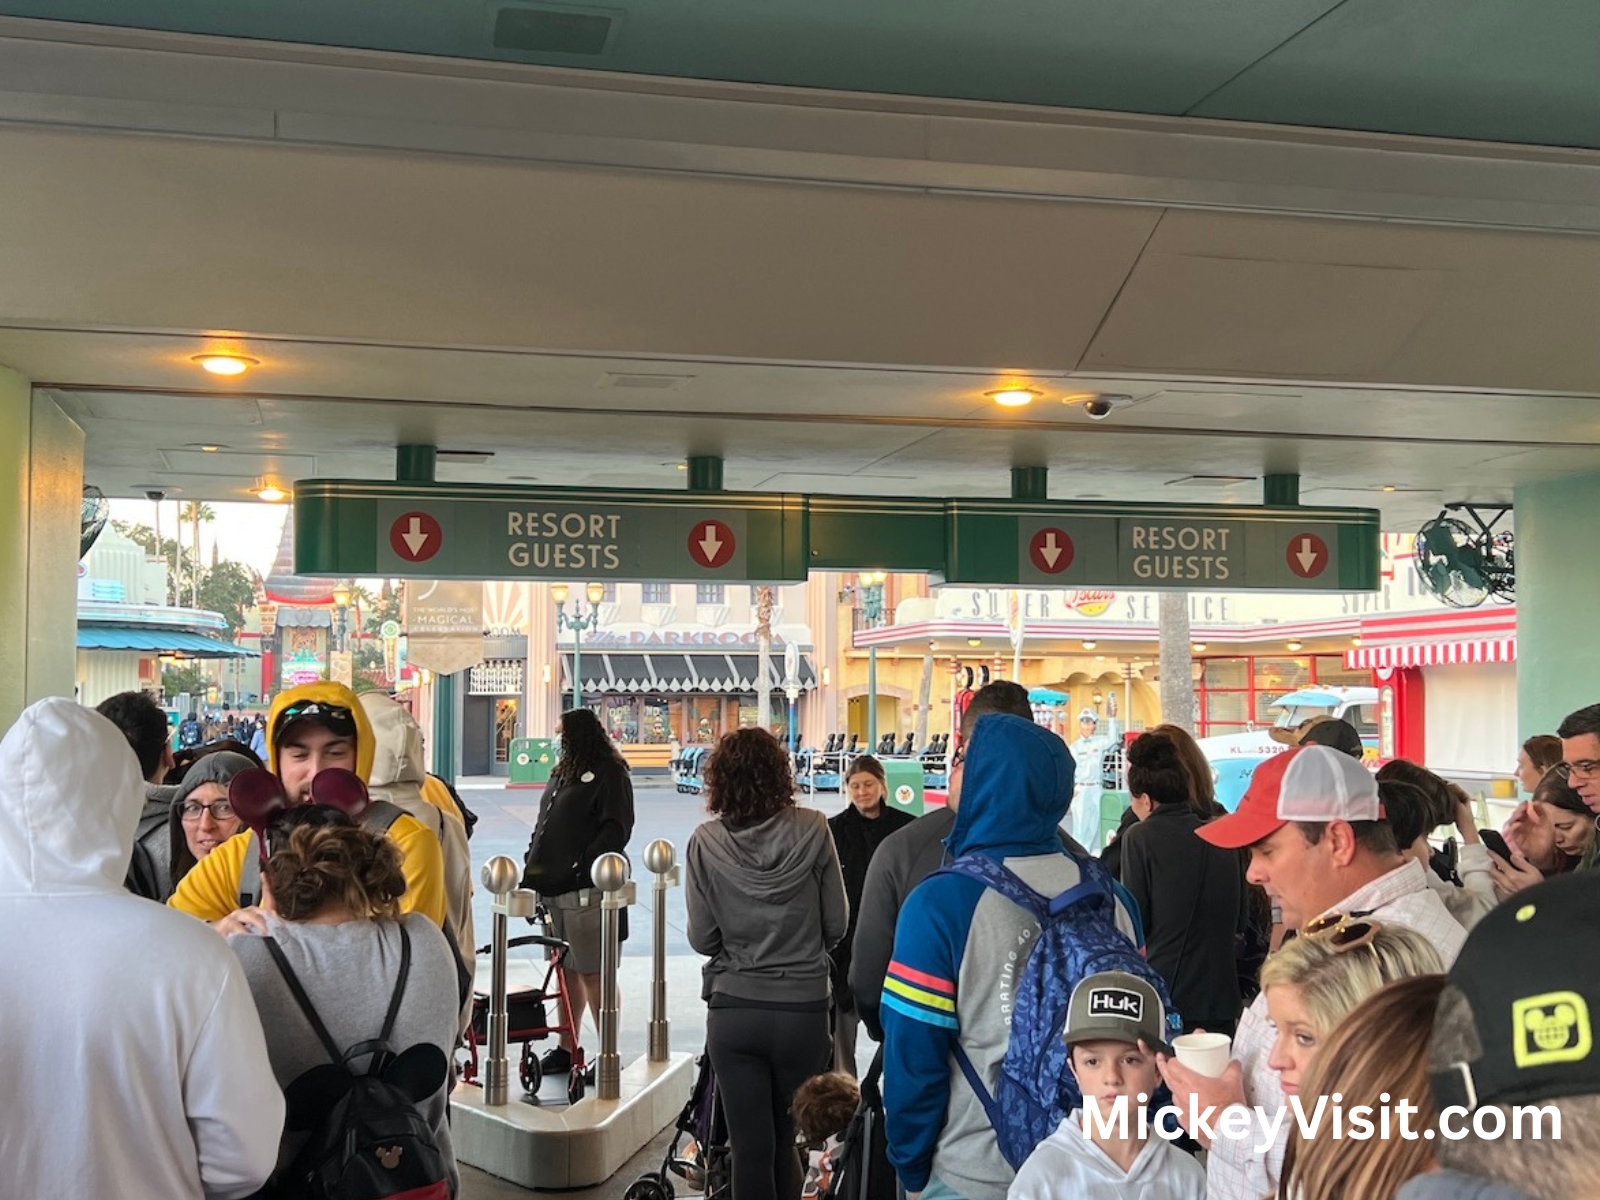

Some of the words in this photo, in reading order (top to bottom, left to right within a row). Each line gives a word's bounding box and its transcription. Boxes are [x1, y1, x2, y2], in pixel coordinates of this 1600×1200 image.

[508, 511, 621, 539] RESORT
[1132, 526, 1230, 551] RESORT
[508, 542, 620, 570] GUESTS
[1133, 555, 1230, 580] GUESTS
[971, 591, 1049, 619] SUER
[1127, 594, 1228, 621] SEICE
[417, 615, 474, 625] MAGICAL
